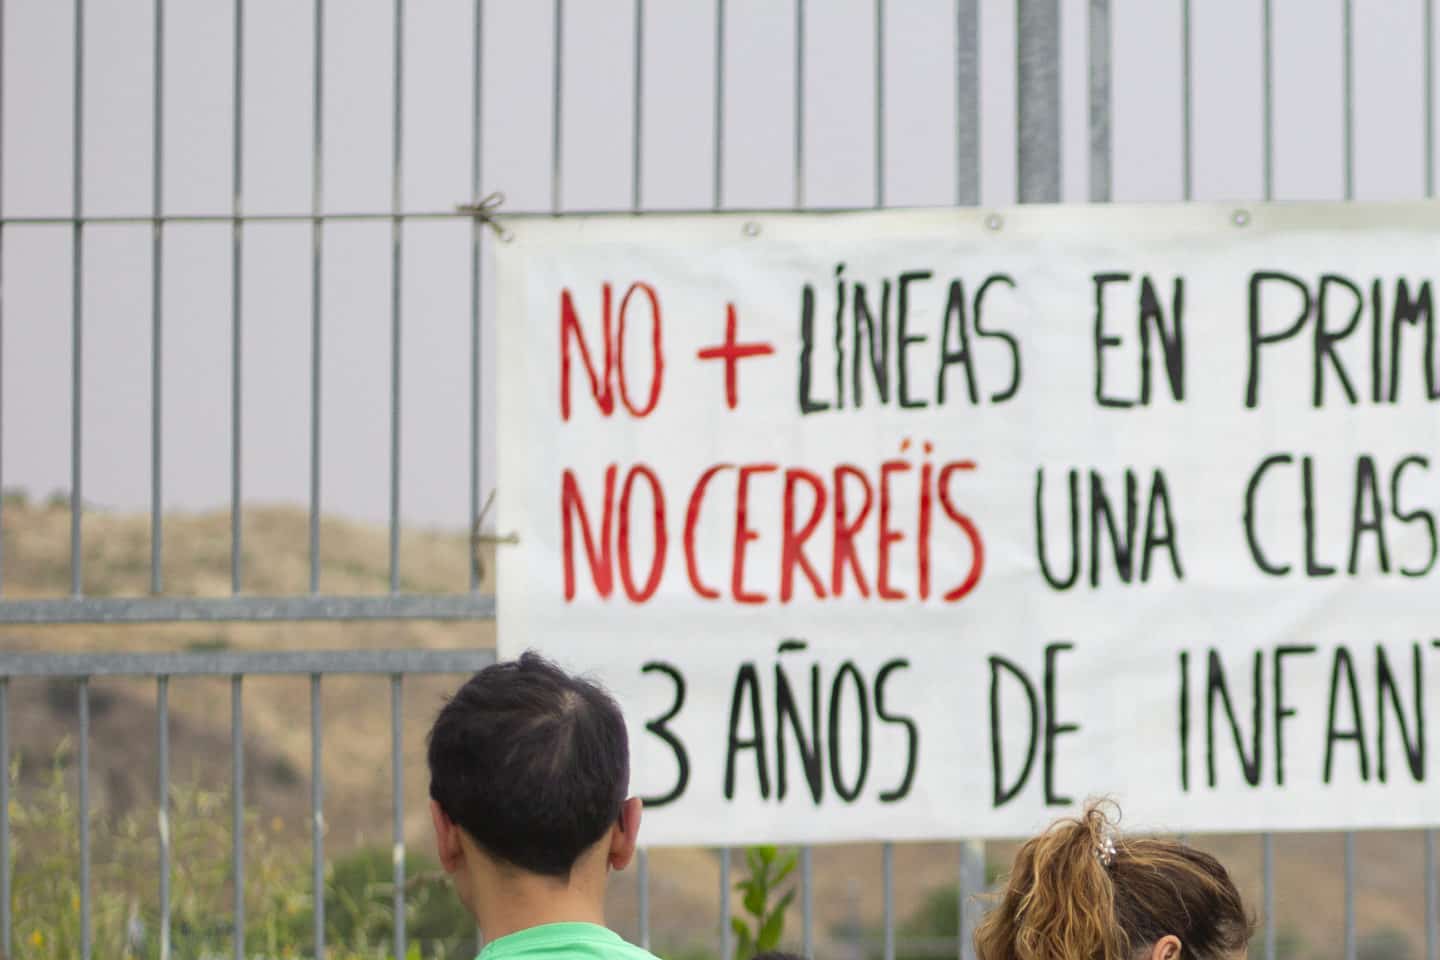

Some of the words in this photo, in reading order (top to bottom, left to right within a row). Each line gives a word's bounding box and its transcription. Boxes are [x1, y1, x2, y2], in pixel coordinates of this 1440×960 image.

[558, 283, 666, 422] NO
[696, 303, 776, 411] +
[797, 262, 1023, 416] LÍNEAS
[1091, 272, 1185, 409] EN
[1034, 469, 1184, 592] UNA
[641, 661, 691, 810] 3
[722, 640, 920, 806] AÑOS
[987, 642, 1079, 808] DE
